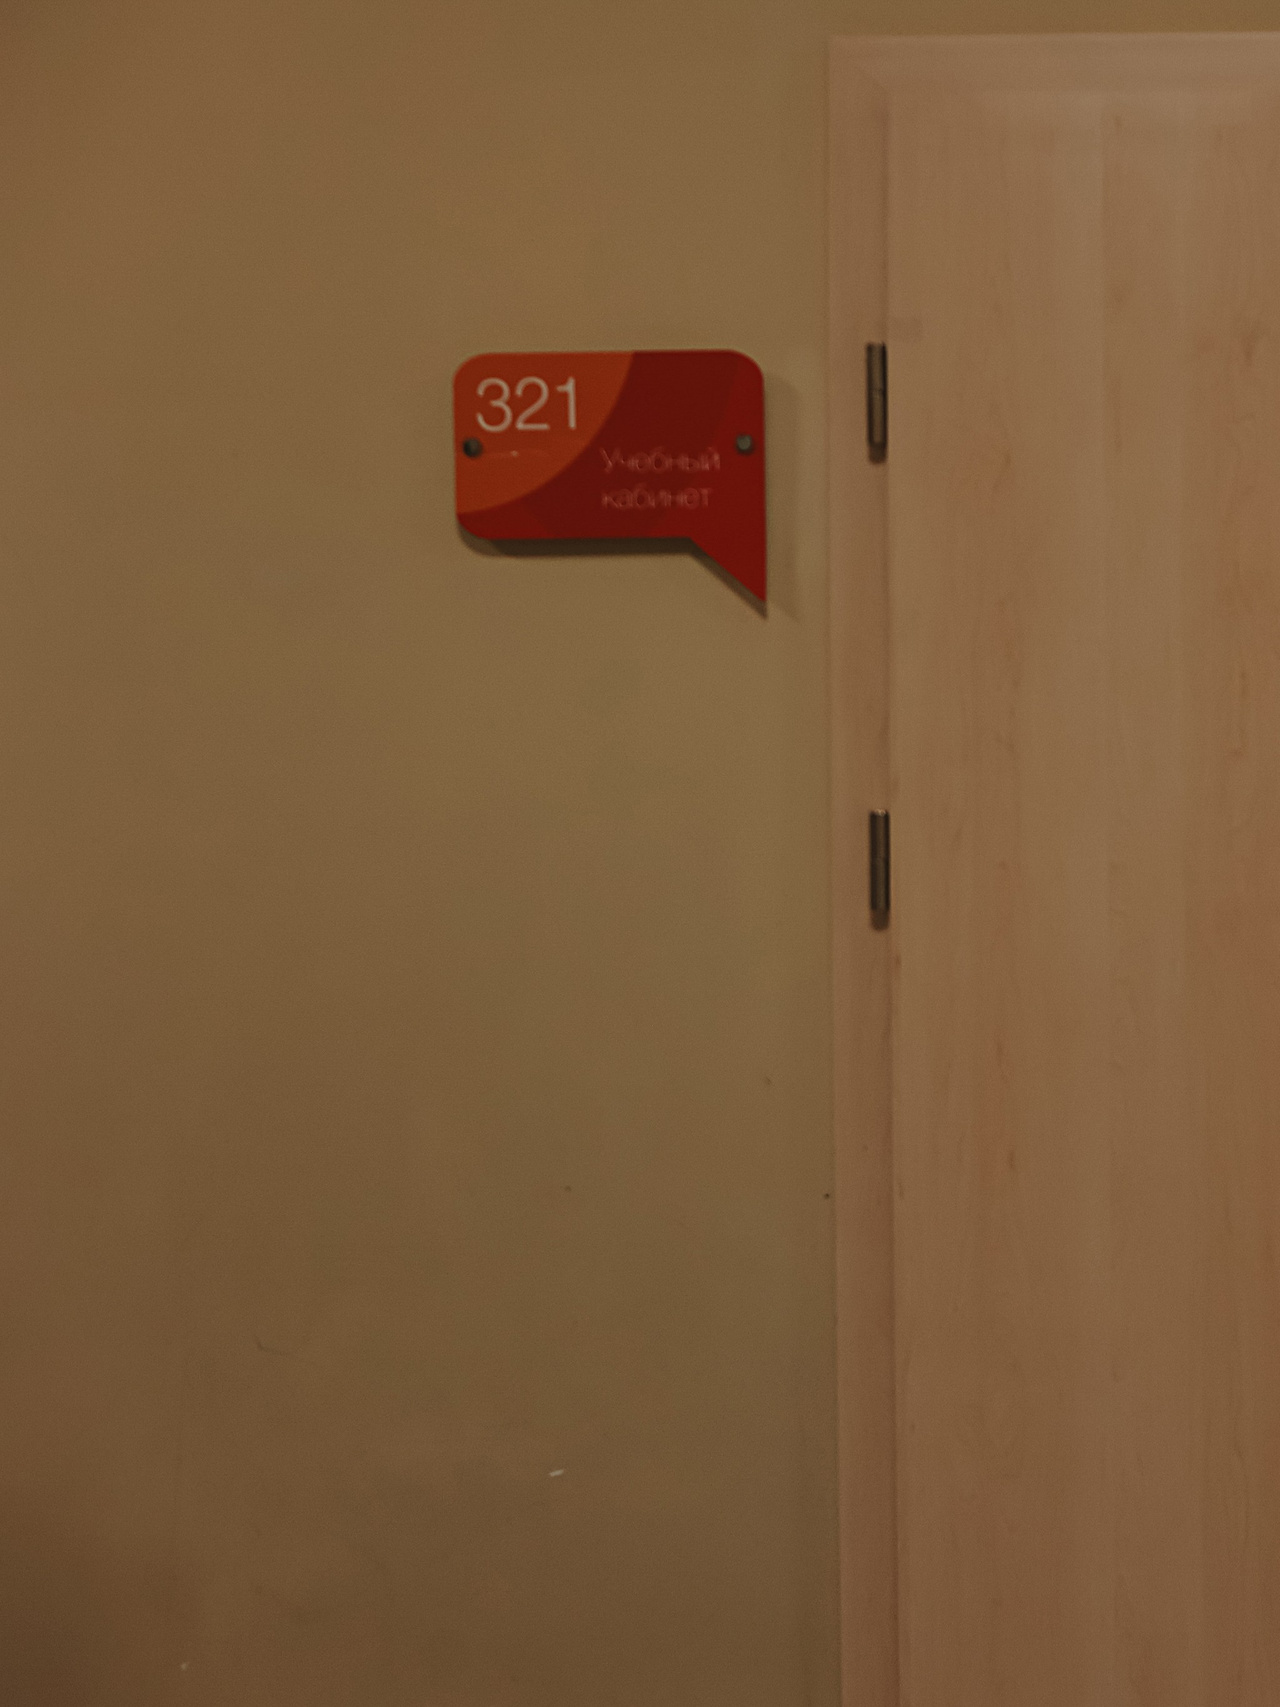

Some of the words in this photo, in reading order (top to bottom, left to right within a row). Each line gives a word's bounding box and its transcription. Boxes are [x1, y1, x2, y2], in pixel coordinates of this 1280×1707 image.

[476, 375, 577, 432] 321
[599, 446, 720, 474] Учебный
[601, 484, 712, 510] кабинет
